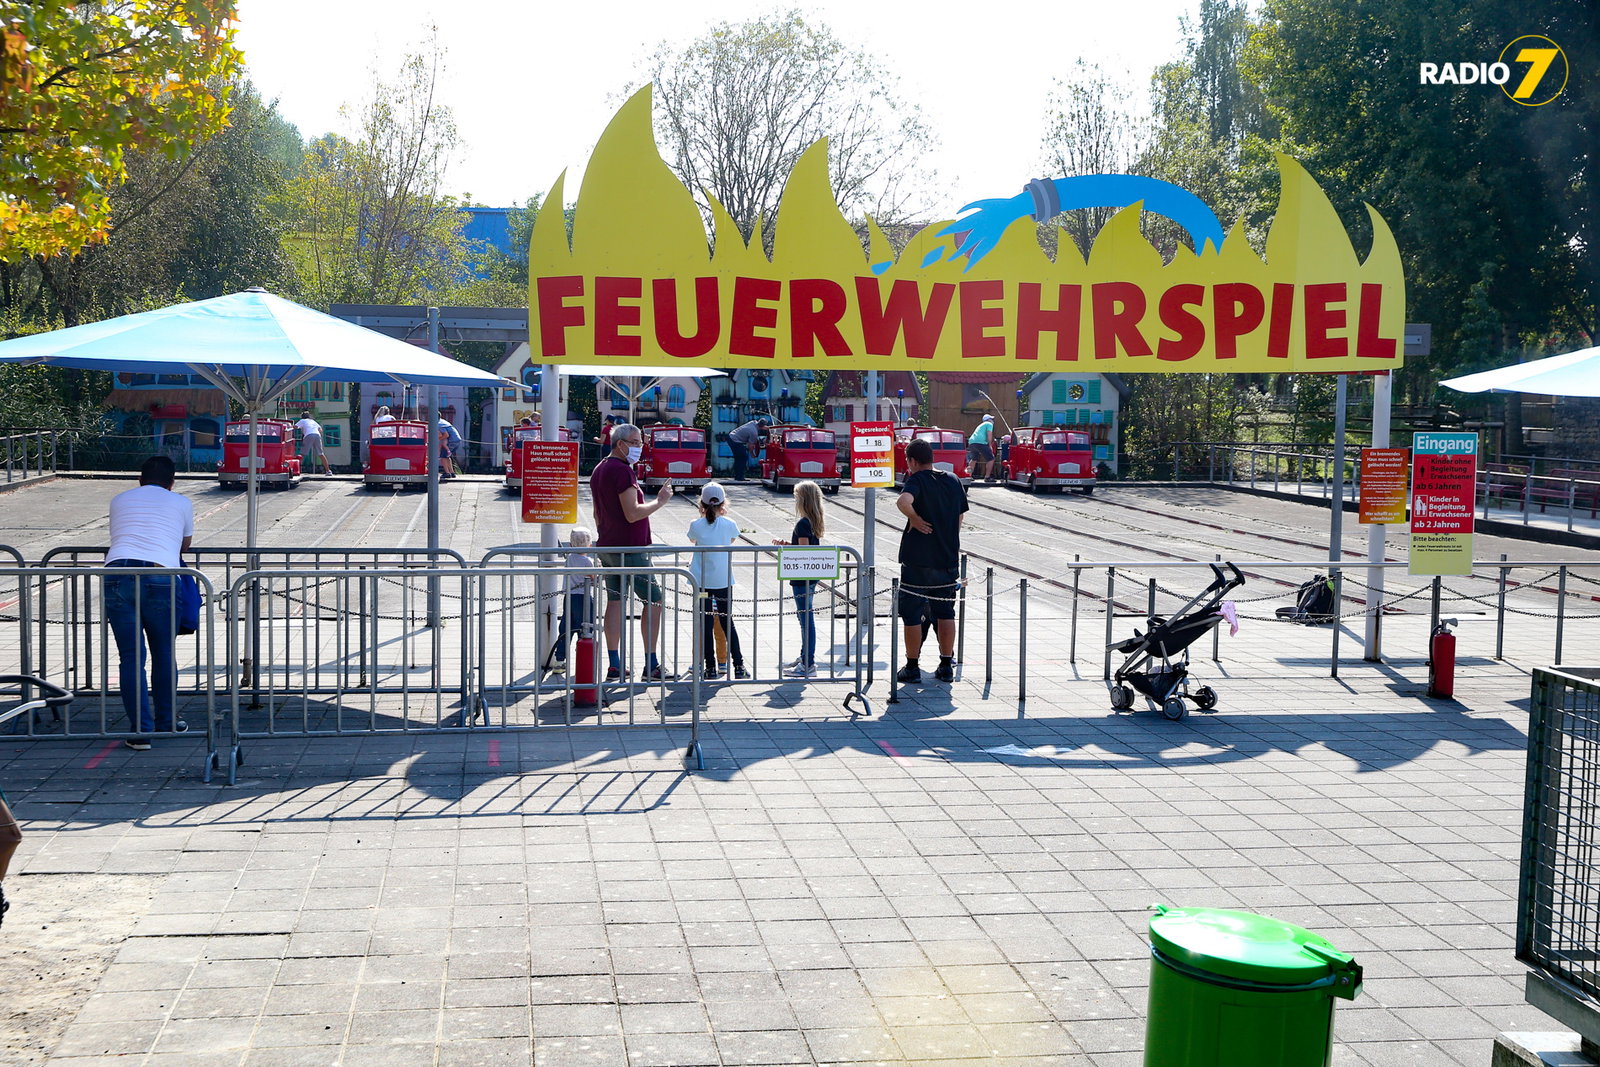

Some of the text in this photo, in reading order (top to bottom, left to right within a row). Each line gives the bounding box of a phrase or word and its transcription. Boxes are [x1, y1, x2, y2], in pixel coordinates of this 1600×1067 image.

[536, 276, 1397, 362] FEUERWEHRSPIEL
[1417, 435, 1474, 454] Eingang
[1430, 466, 1468, 474] Begleitung
[1429, 495, 1452, 503] Kinder
[1428, 503, 1466, 511] Begleitung
[1414, 520, 1425, 528] ab
[1432, 520, 1460, 528] Jahren
